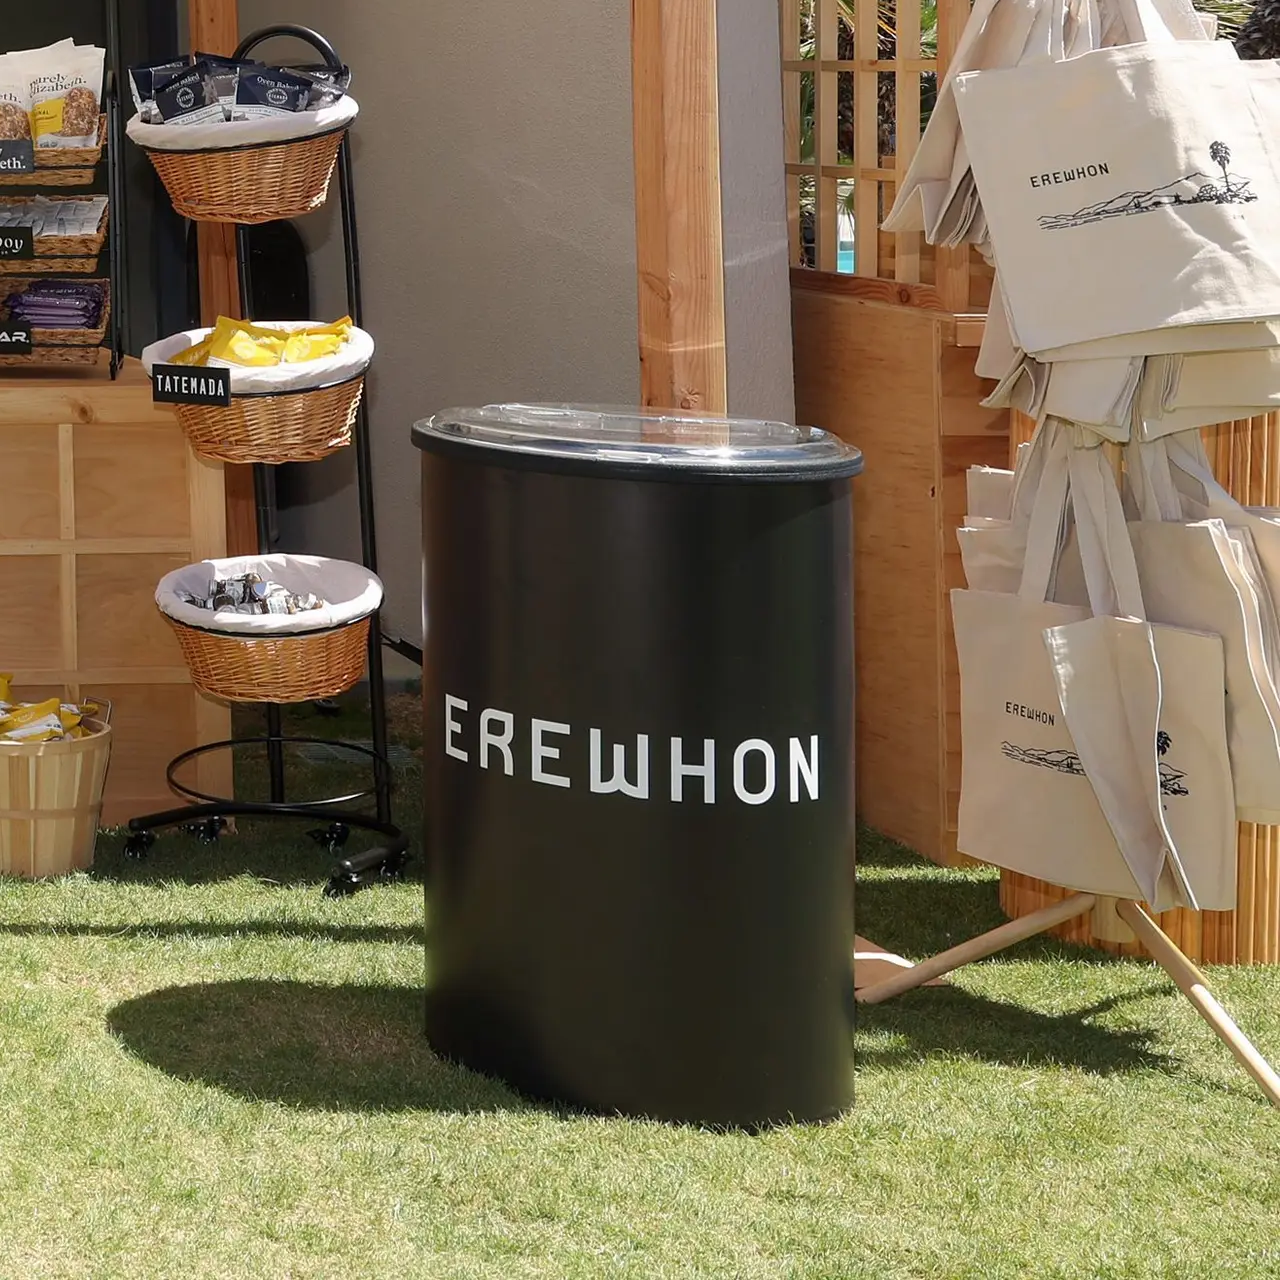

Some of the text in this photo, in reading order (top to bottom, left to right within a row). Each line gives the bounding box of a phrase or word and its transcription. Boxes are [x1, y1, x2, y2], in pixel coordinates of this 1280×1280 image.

[1030, 162, 1110, 188] EREWHON
[156, 374, 225, 397] TATEMADA
[1005, 701, 1056, 727] EREWHON
[445, 693, 820, 805] EREWHON
